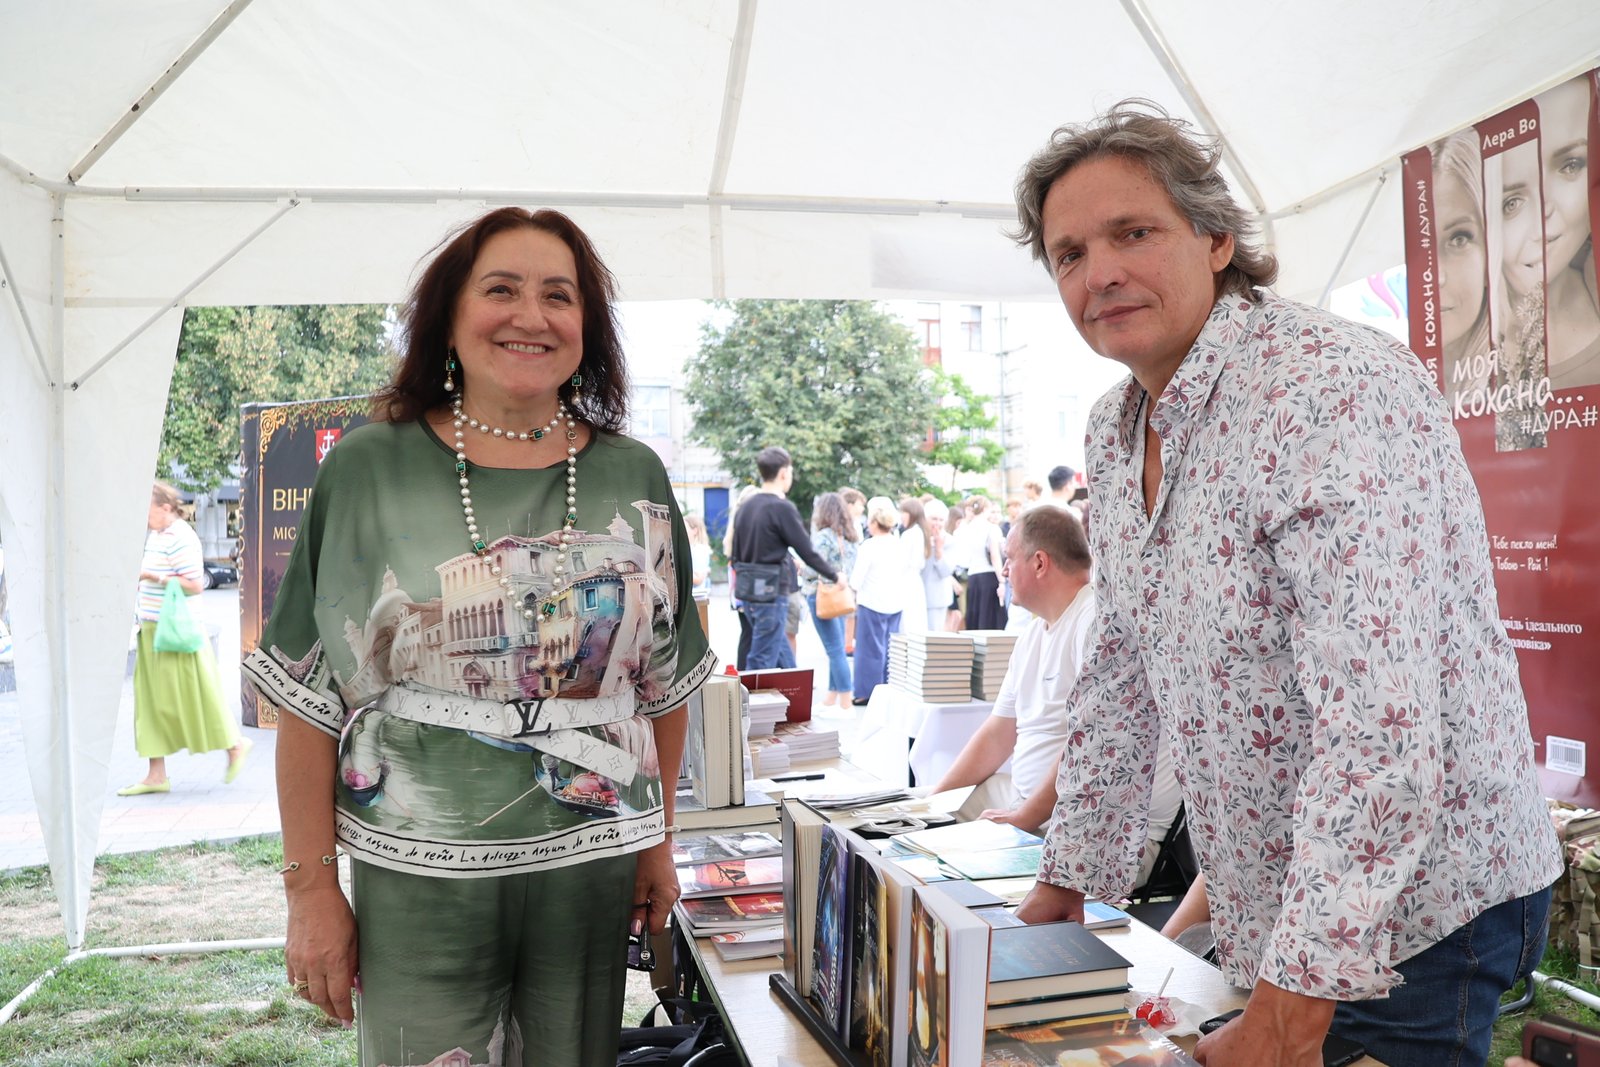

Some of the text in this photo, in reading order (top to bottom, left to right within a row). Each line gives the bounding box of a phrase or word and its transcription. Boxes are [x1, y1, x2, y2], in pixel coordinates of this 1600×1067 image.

[1482, 118, 1537, 150] Лера Во
[1520, 405, 1598, 436] #ДУРА#
[1525, 617, 1582, 633] ідеального
[1510, 637, 1552, 650] оловіка»
[424, 849, 454, 861] verão
[589, 828, 620, 843] verão
